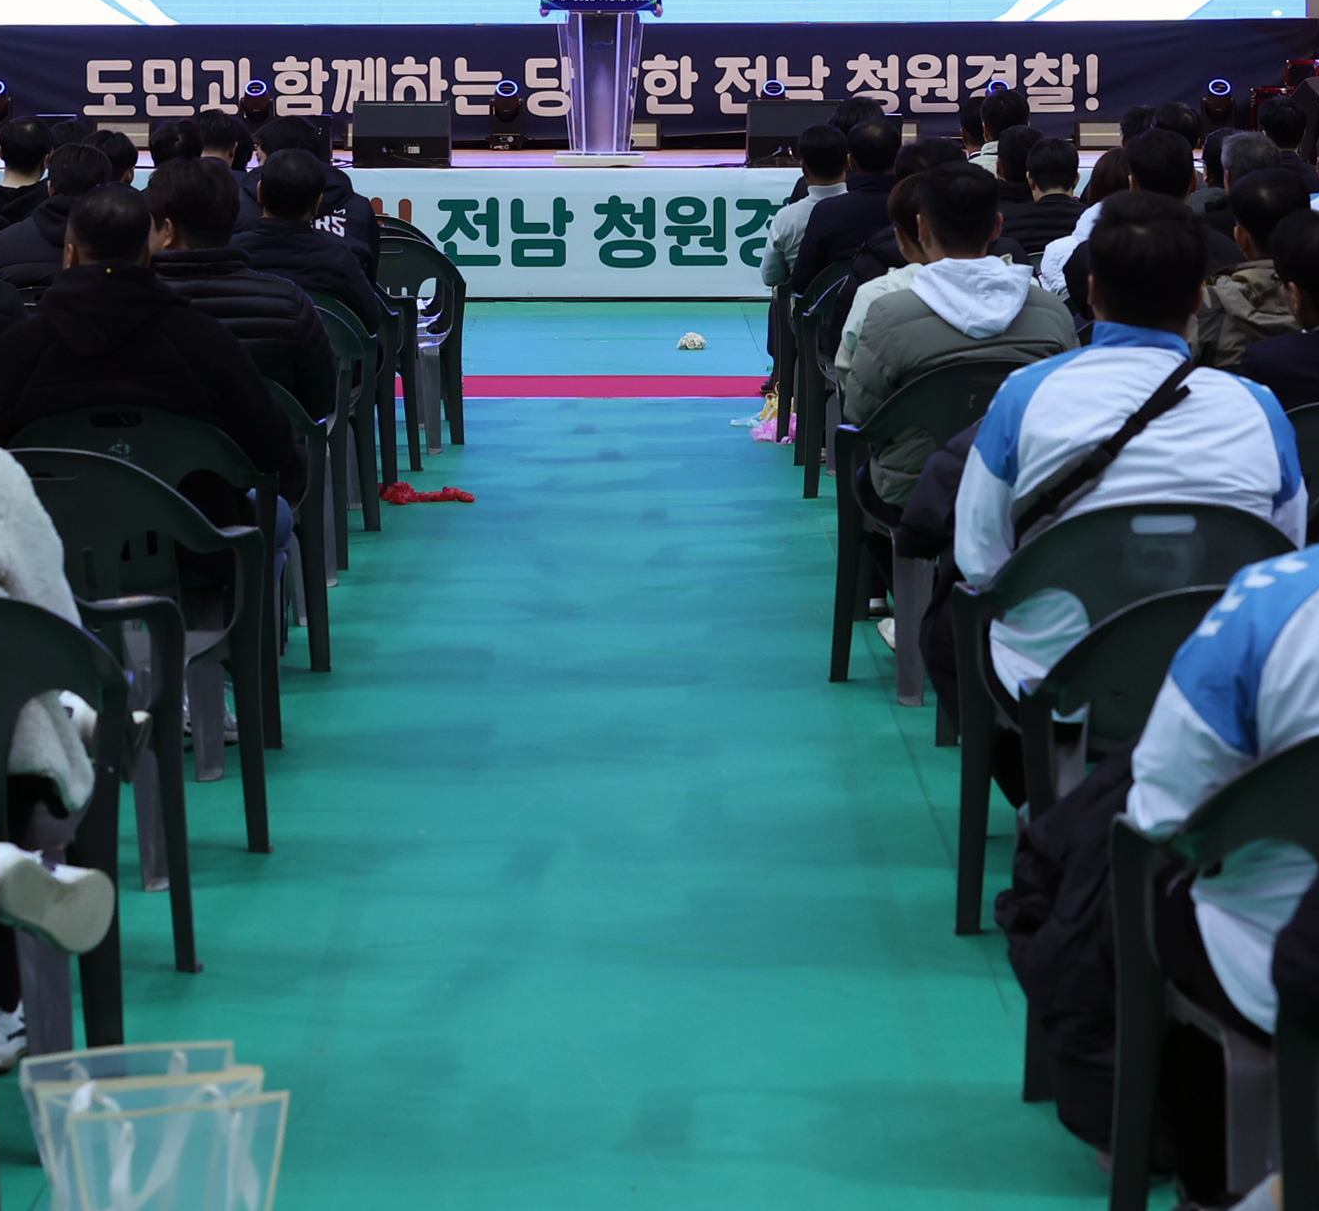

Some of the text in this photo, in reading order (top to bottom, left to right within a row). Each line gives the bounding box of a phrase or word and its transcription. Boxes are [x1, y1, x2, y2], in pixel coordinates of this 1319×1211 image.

[82, 55, 253, 118] 도민과
[271, 54, 507, 117] 함께하는
[524, 54, 699, 117] 당한
[436, 196, 575, 268] 전남
